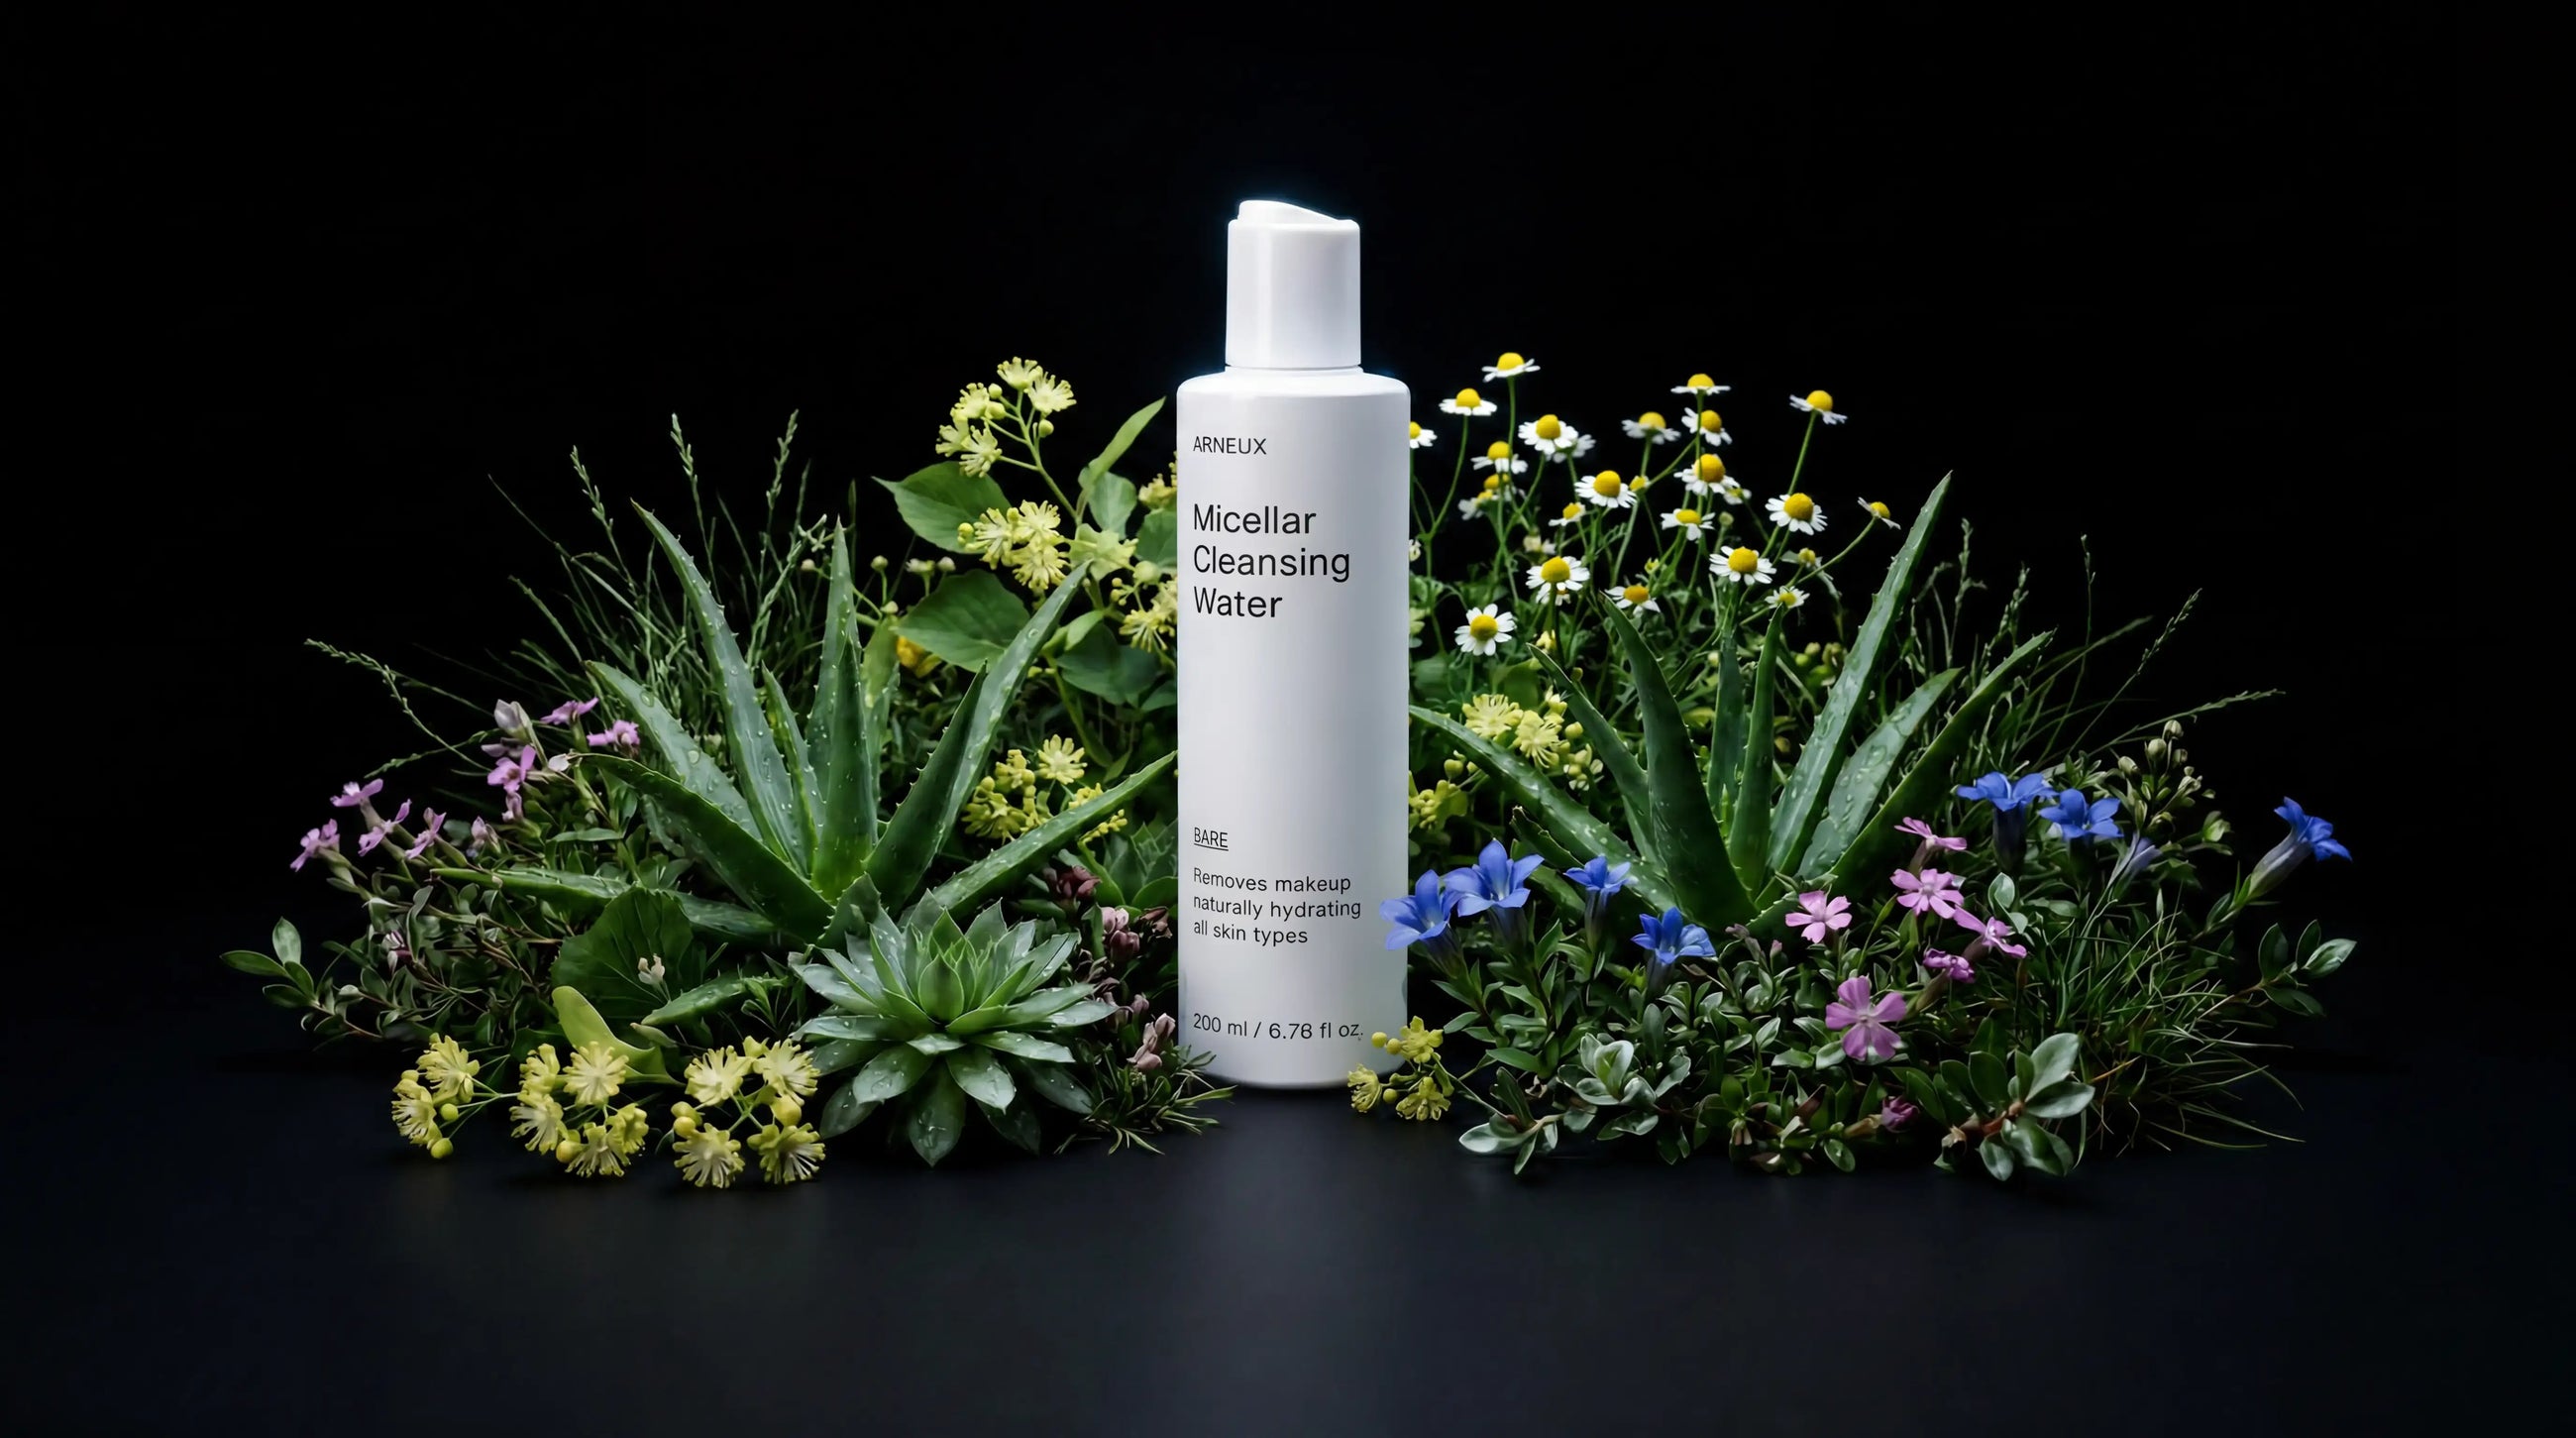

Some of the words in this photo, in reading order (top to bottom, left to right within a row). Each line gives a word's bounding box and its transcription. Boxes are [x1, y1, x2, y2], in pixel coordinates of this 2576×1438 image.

[1192, 435, 1266, 455] ARNEUX
[1193, 502, 1317, 534] Micellar
[1193, 544, 1349, 583] Cleansing
[1193, 585, 1283, 617] Water
[1193, 826, 1228, 848] BARE
[1193, 866, 1267, 891] Removes
[1275, 875, 1350, 895] makeup
[1193, 895, 1262, 921] naturally
[1268, 899, 1360, 922] hydrating
[1193, 919, 1208, 936] all
[1212, 922, 1245, 940] skin
[1252, 927, 1308, 947] types
[1193, 1012, 1221, 1033] 200
[1227, 1020, 1246, 1037] ml
[1252, 1021, 1261, 1038] /
[1319, 1022, 1332, 1039] fl
[1338, 1023, 1363, 1038] oz.
